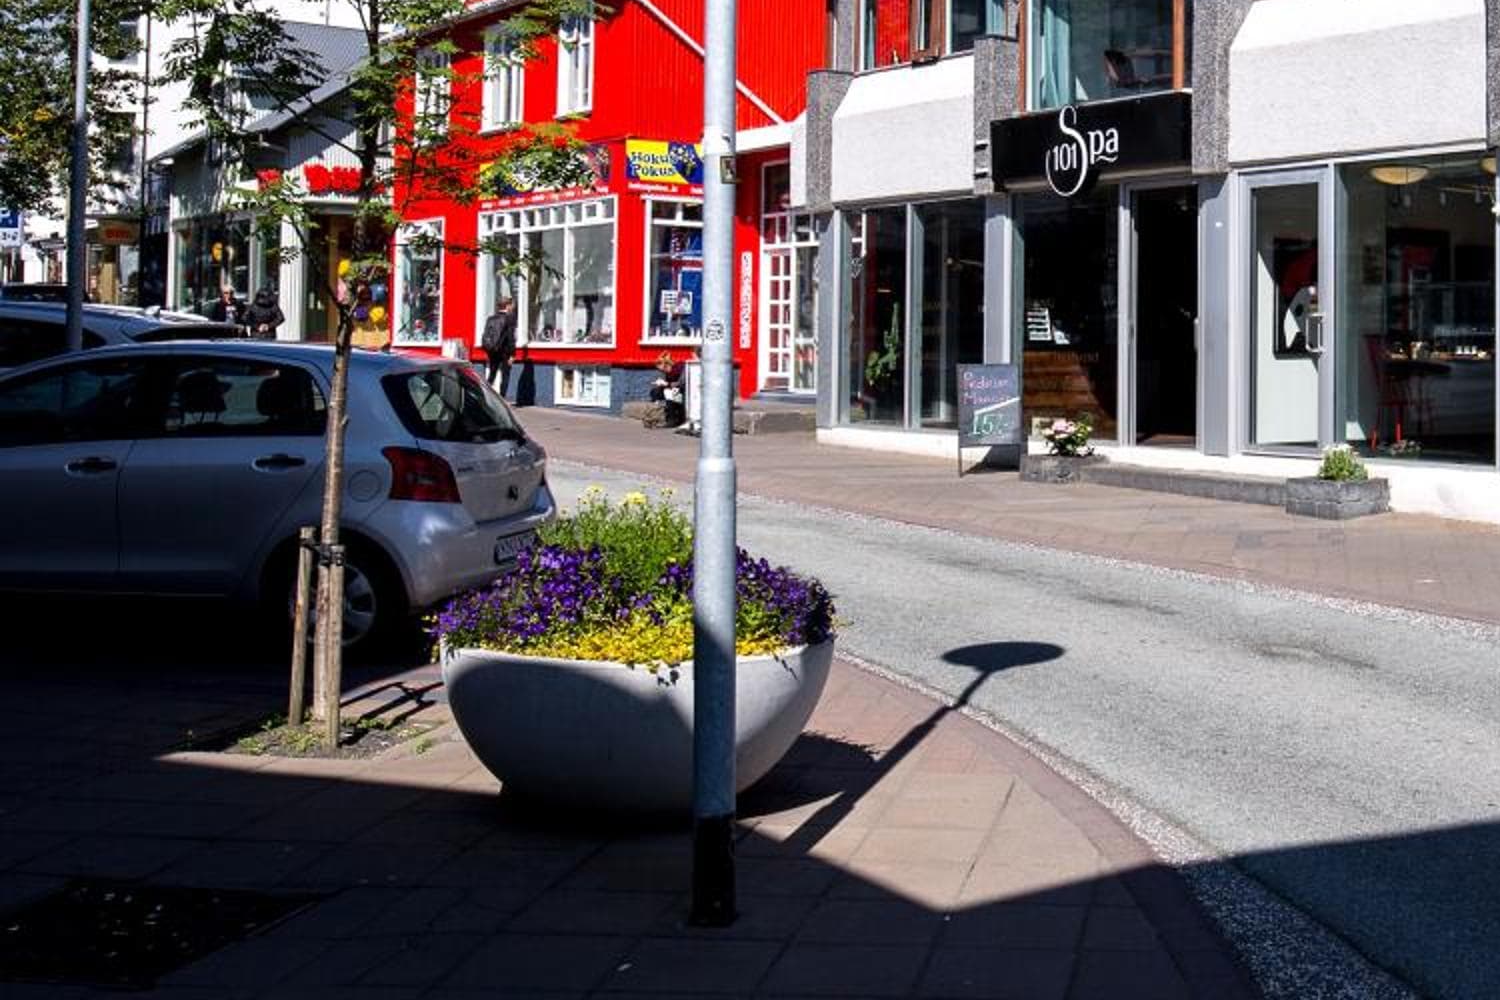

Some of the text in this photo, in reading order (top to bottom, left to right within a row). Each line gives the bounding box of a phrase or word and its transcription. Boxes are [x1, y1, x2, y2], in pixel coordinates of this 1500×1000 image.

[630, 163, 674, 177] Pokus
[1045, 105, 1119, 197] 101 Spa
